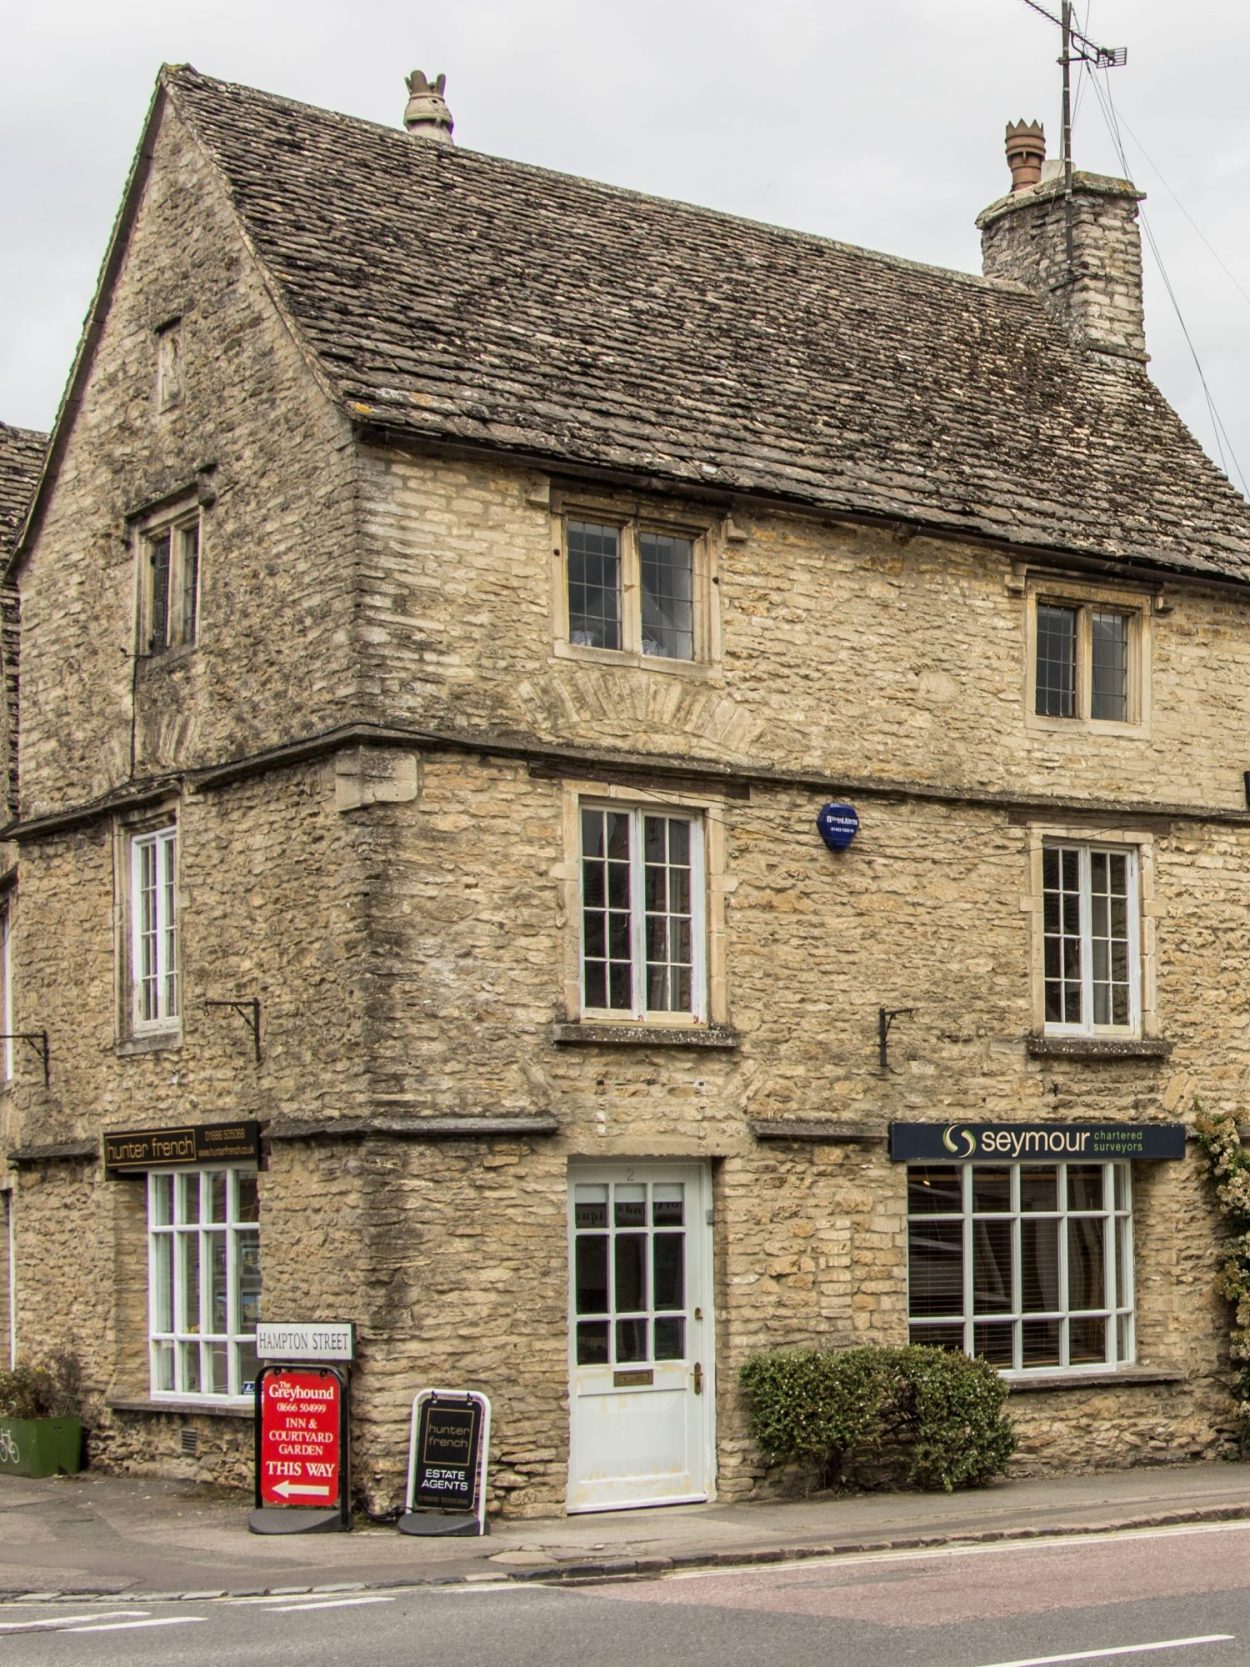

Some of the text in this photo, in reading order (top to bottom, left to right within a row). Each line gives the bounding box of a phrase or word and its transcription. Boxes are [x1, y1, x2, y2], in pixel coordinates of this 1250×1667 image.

[1094, 1130, 1143, 1140] chartered
[108, 1136, 193, 1160] hunter french
[981, 1131, 1090, 1157] seymour
[1093, 1143, 1143, 1154] surveyors
[626, 1168, 634, 1181] 2
[259, 1332, 348, 1350] HAMPTON STREET
[269, 1384, 334, 1402] Greyhound
[299, 1404, 327, 1413] 504999
[285, 1418, 317, 1429] INN &
[428, 1424, 470, 1435] hunter
[269, 1430, 334, 1443] COURTYARD
[429, 1436, 468, 1447] french
[279, 1444, 323, 1455] GARDEN
[266, 1461, 335, 1477] THIS WAY
[425, 1469, 465, 1480] ESTATE
[421, 1479, 468, 1491] AGENTS
